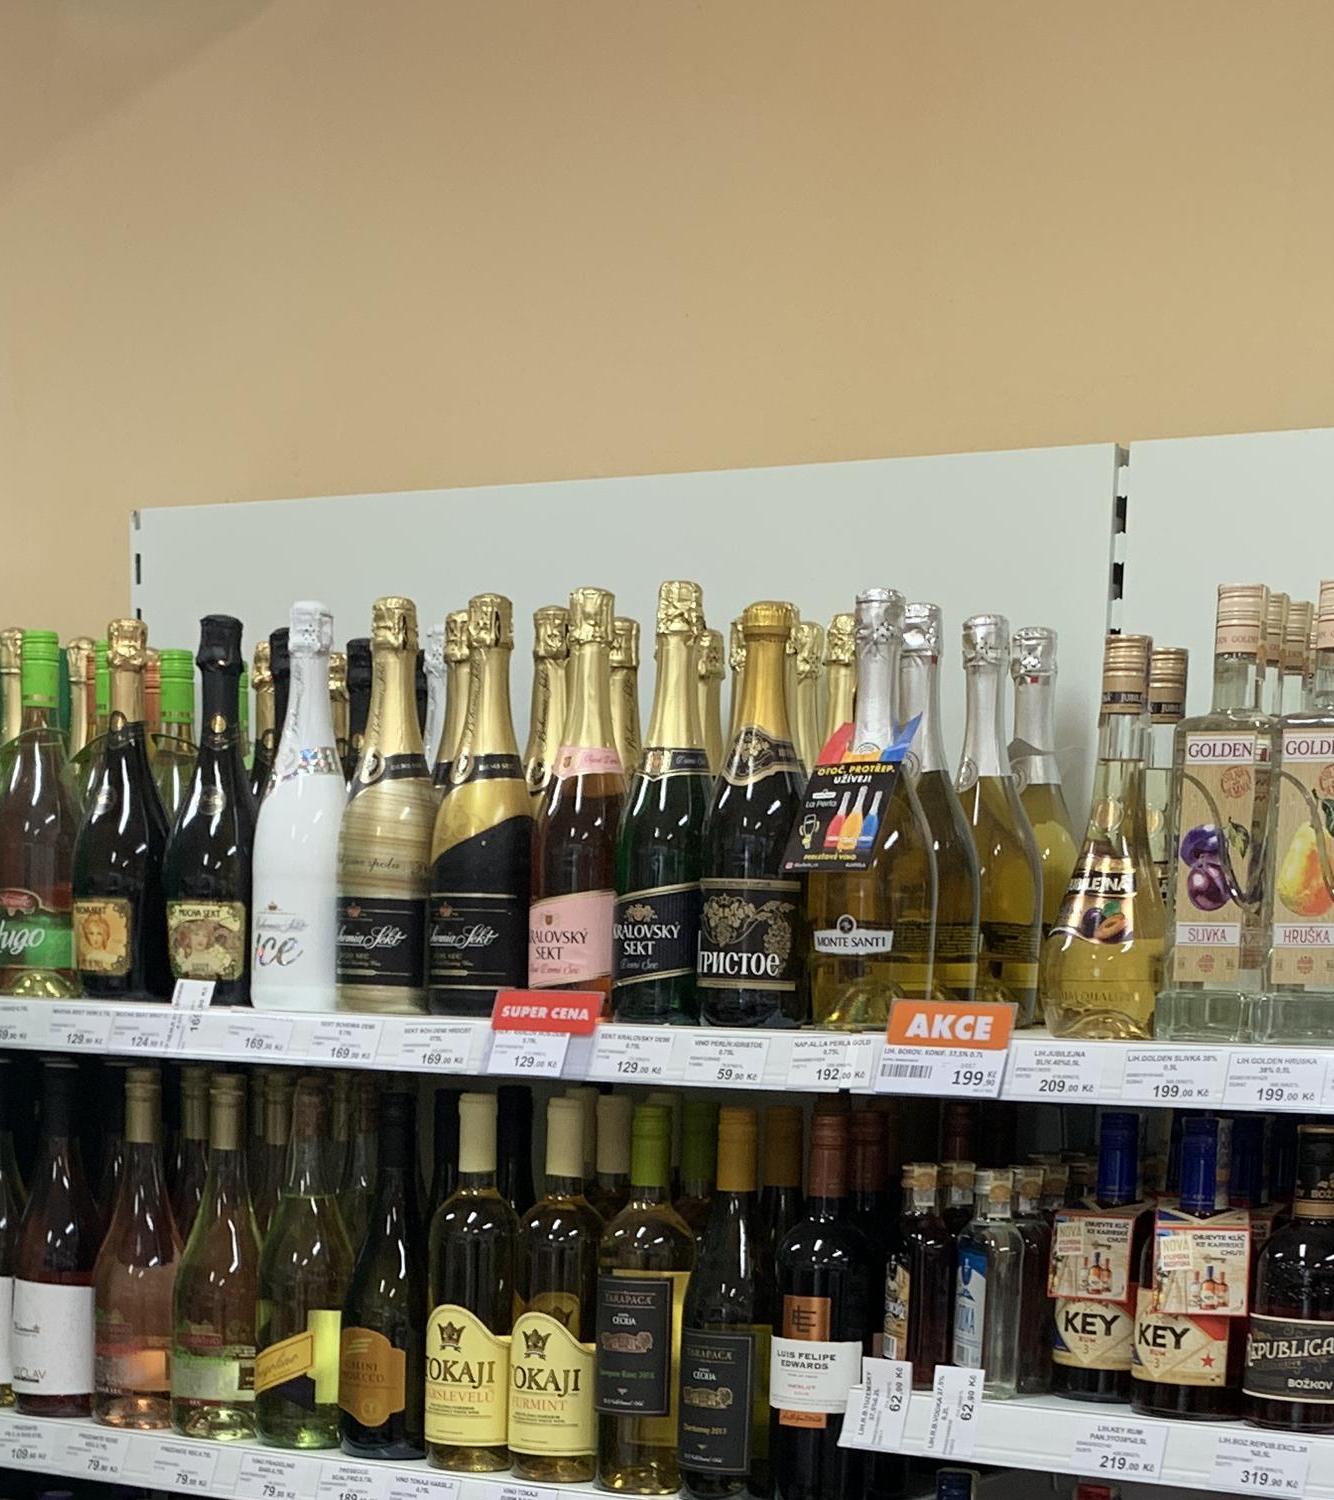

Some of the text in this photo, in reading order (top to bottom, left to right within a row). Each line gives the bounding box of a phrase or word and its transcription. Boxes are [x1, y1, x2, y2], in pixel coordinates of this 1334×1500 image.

[1187, 740, 1254, 759] GOLDEN
[851, 936, 886, 947] SANTI
[1187, 927, 1227, 943] SLIVKA
[1283, 925, 1331, 943] HRUŠKA
[535, 944, 563, 961] SEKT
[624, 939, 655, 956] SEKT
[501, 1005, 590, 1023] SUPER CENA
[905, 1013, 994, 1041] AKCE
[1064, 1310, 1121, 1337] KEY
[1138, 1324, 1191, 1351] KEY
[779, 1359, 830, 1371] EDWARDS
[795, 1351, 836, 1363] FELIPE
[1287, 1376, 1333, 1391] BOŽKOV
